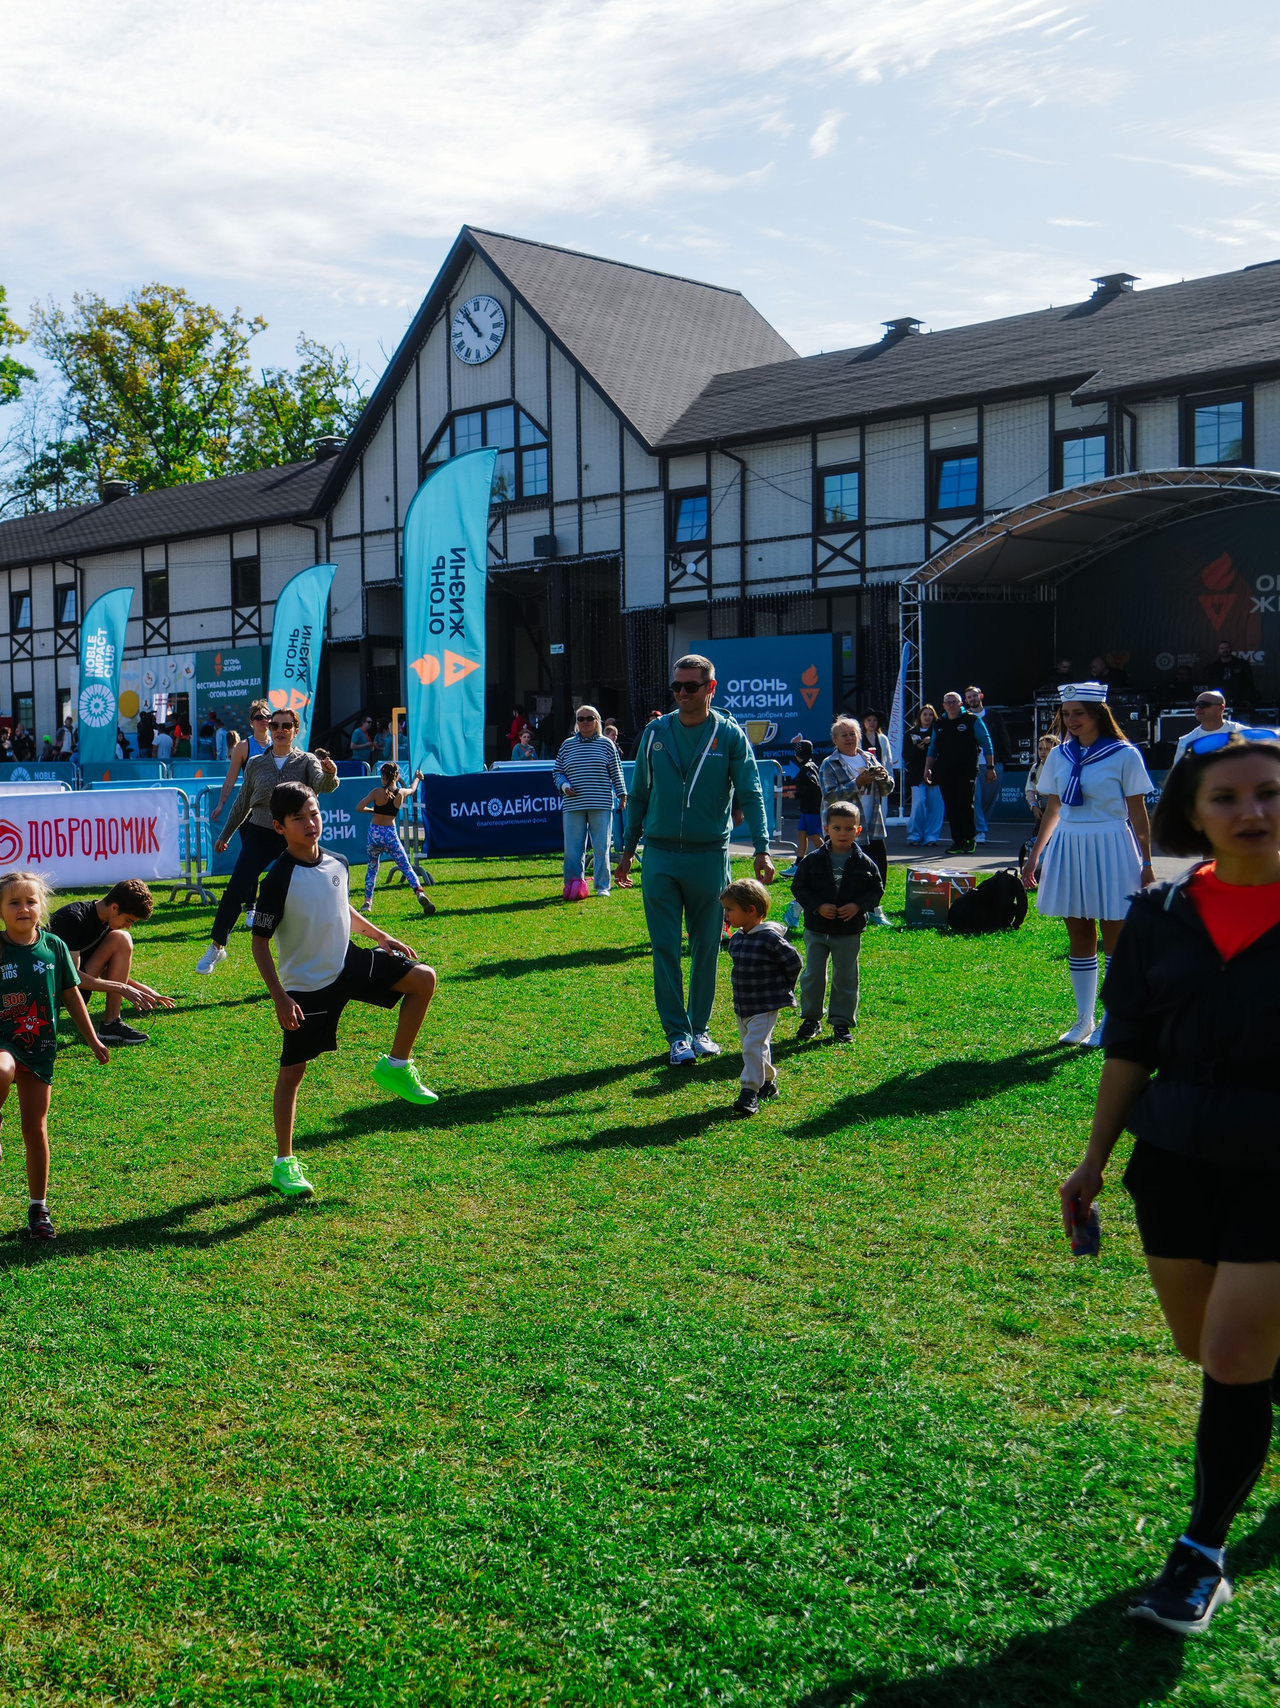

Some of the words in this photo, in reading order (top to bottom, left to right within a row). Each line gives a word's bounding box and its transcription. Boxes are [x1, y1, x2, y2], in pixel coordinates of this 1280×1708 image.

[429, 555, 446, 635] ОГОНЬ
[448, 547, 466, 640] ЖИЗНИ
[85, 635, 98, 677] NOBLE
[94, 628, 108, 678] IMPACT
[284, 628, 300, 679] ОГОНЬ
[296, 625, 312, 683] ЖИЗНИ
[104, 645, 115, 678] CLUB
[196, 680, 227, 690] ФЕСТИВАЛЬ
[227, 679, 250, 688] ДОБРЫХ
[250, 678, 261, 686] ДЕЛ
[727, 679, 788, 693] ОГОНЬ
[723, 693, 793, 708] ЖИЗНИ
[756, 710, 782, 719] добрых
[784, 711, 798, 719] дел
[34, 772, 56, 780] NOBLE
[450, 795, 564, 817] БЛАГОДЕЙСТВИ
[321, 809, 351, 824] ОНЬ
[476, 818, 531, 827] благотворительный
[532, 816, 547, 824] фонд
[27, 816, 161, 864] ДОБРОДОМИК
[321, 825, 356, 841] ЗНИ
[0, 964, 14, 972] STAR
[2, 970, 18, 980] KIDS
[3, 992, 26, 1007] 500
